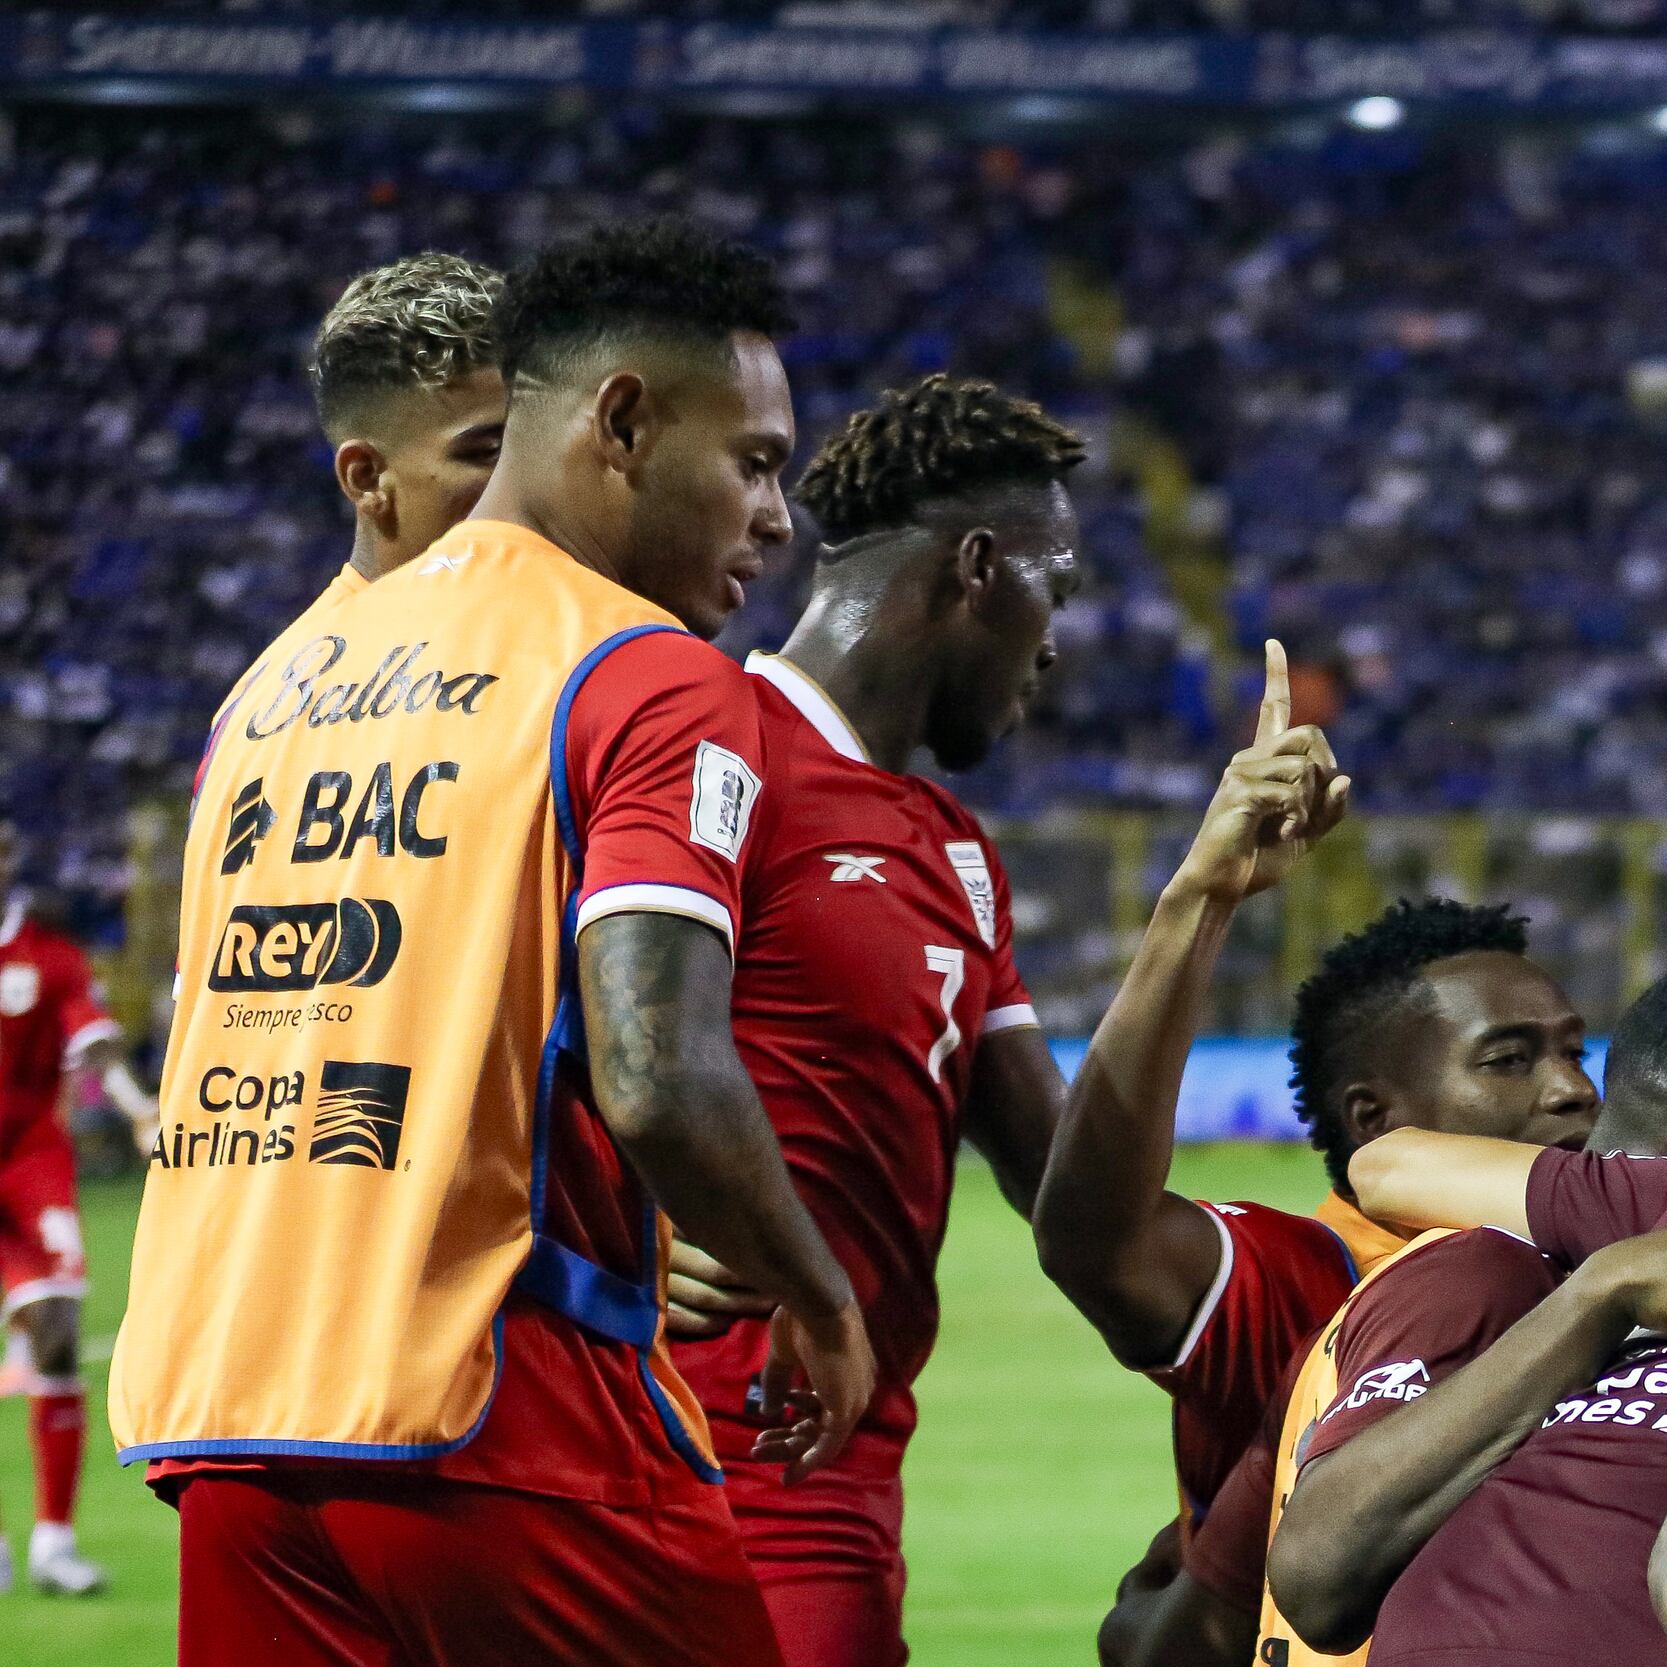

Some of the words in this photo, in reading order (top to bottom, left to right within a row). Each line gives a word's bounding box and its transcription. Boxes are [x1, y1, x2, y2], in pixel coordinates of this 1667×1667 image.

[246, 635, 500, 742] Balboa
[291, 761, 460, 864] BAC
[223, 1004, 301, 1034] Siempre
[199, 1066, 305, 1121] Copa
